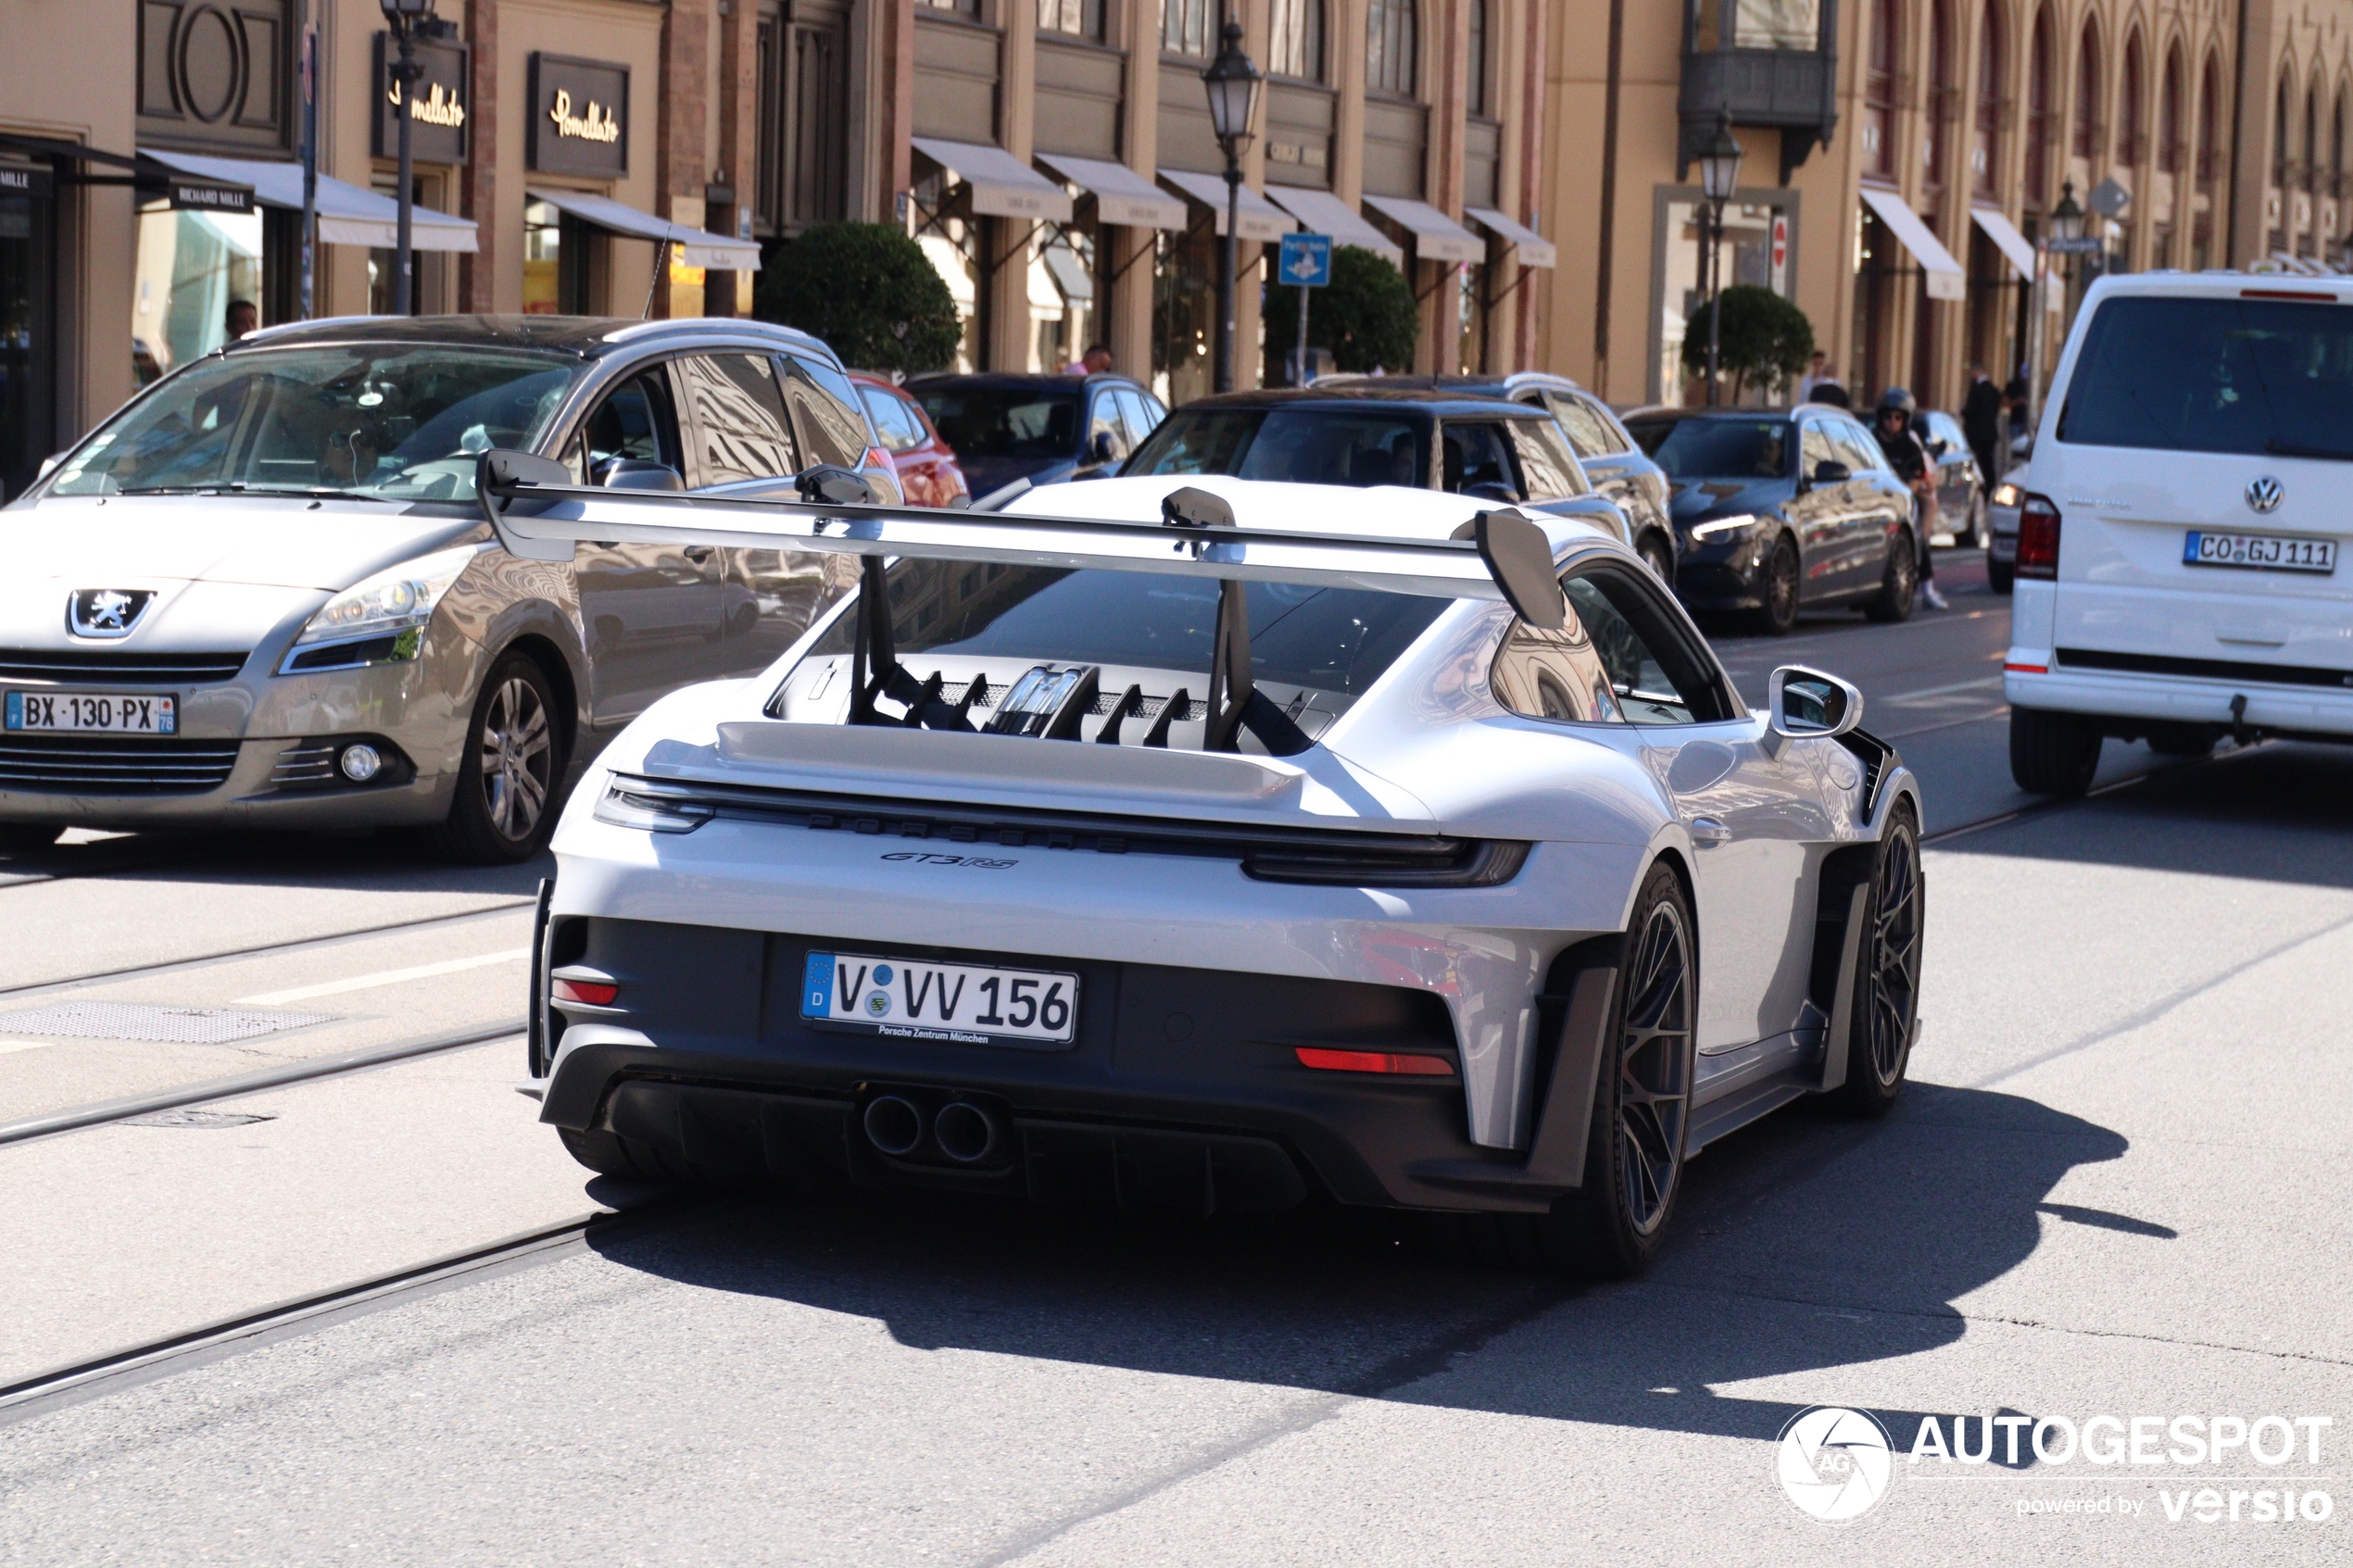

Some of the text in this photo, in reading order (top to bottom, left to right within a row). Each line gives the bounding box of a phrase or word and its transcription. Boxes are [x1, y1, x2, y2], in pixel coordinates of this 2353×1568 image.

[388, 80, 465, 127] mellato
[551, 89, 619, 143] Pomellato
[179, 187, 245, 207] RICHARD MILLE
[2200, 536, 2330, 566] CO GJ 111
[160, 716, 174, 730] 78
[812, 992, 824, 1007] D
[837, 964, 1069, 1031] V VV 156
[878, 1025, 988, 1044] Porsche Zentrum München
